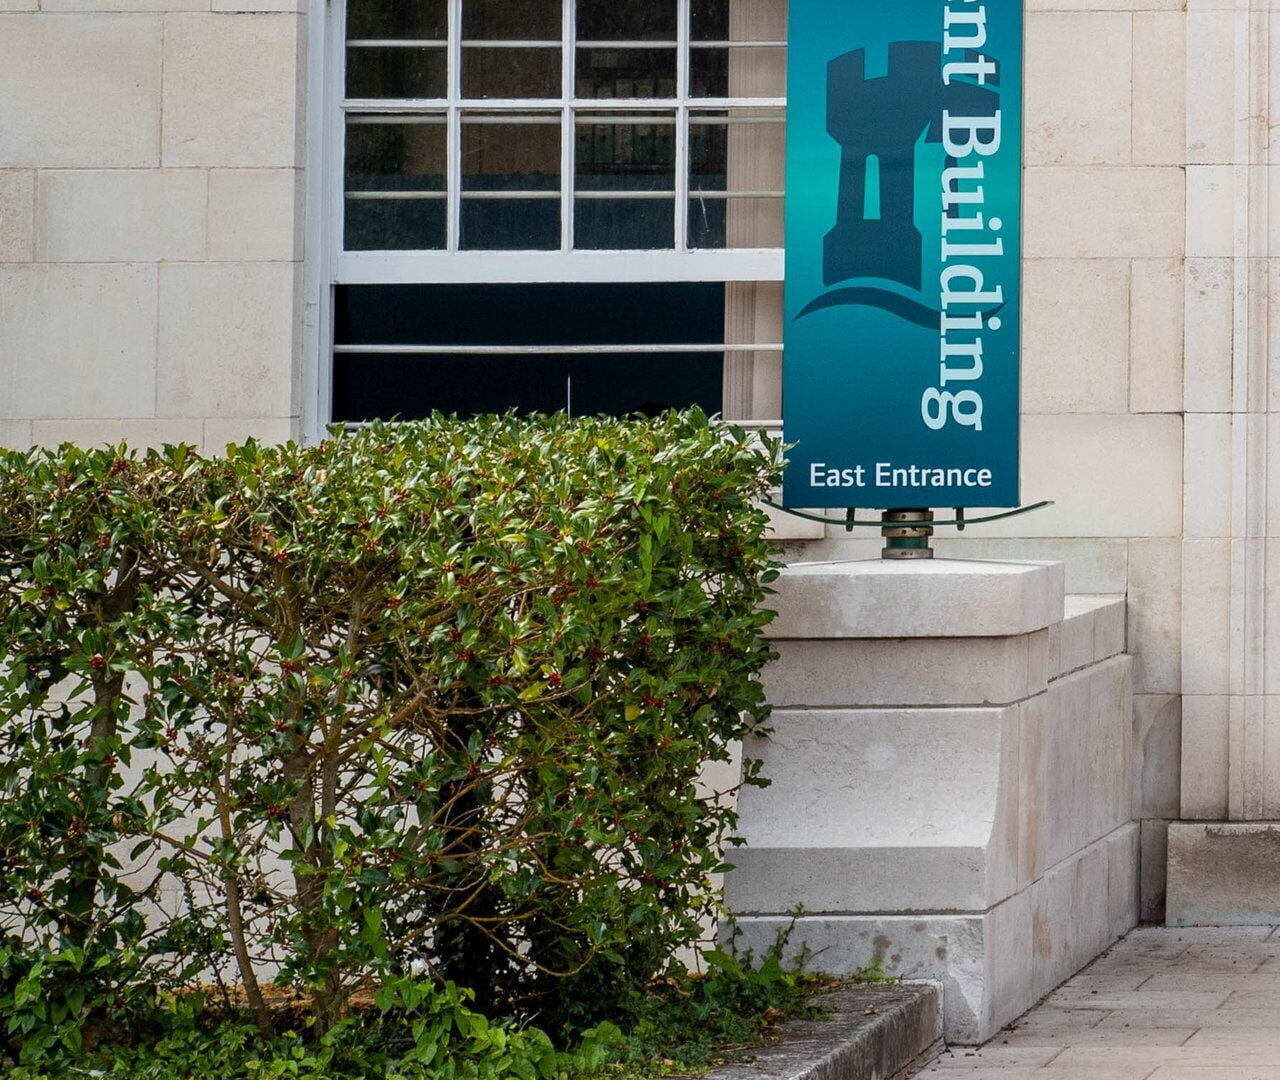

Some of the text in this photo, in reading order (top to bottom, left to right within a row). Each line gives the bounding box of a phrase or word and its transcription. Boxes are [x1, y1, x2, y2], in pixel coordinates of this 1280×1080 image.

[921, 109, 1004, 431] Building
[810, 463, 992, 487] East Entrance
